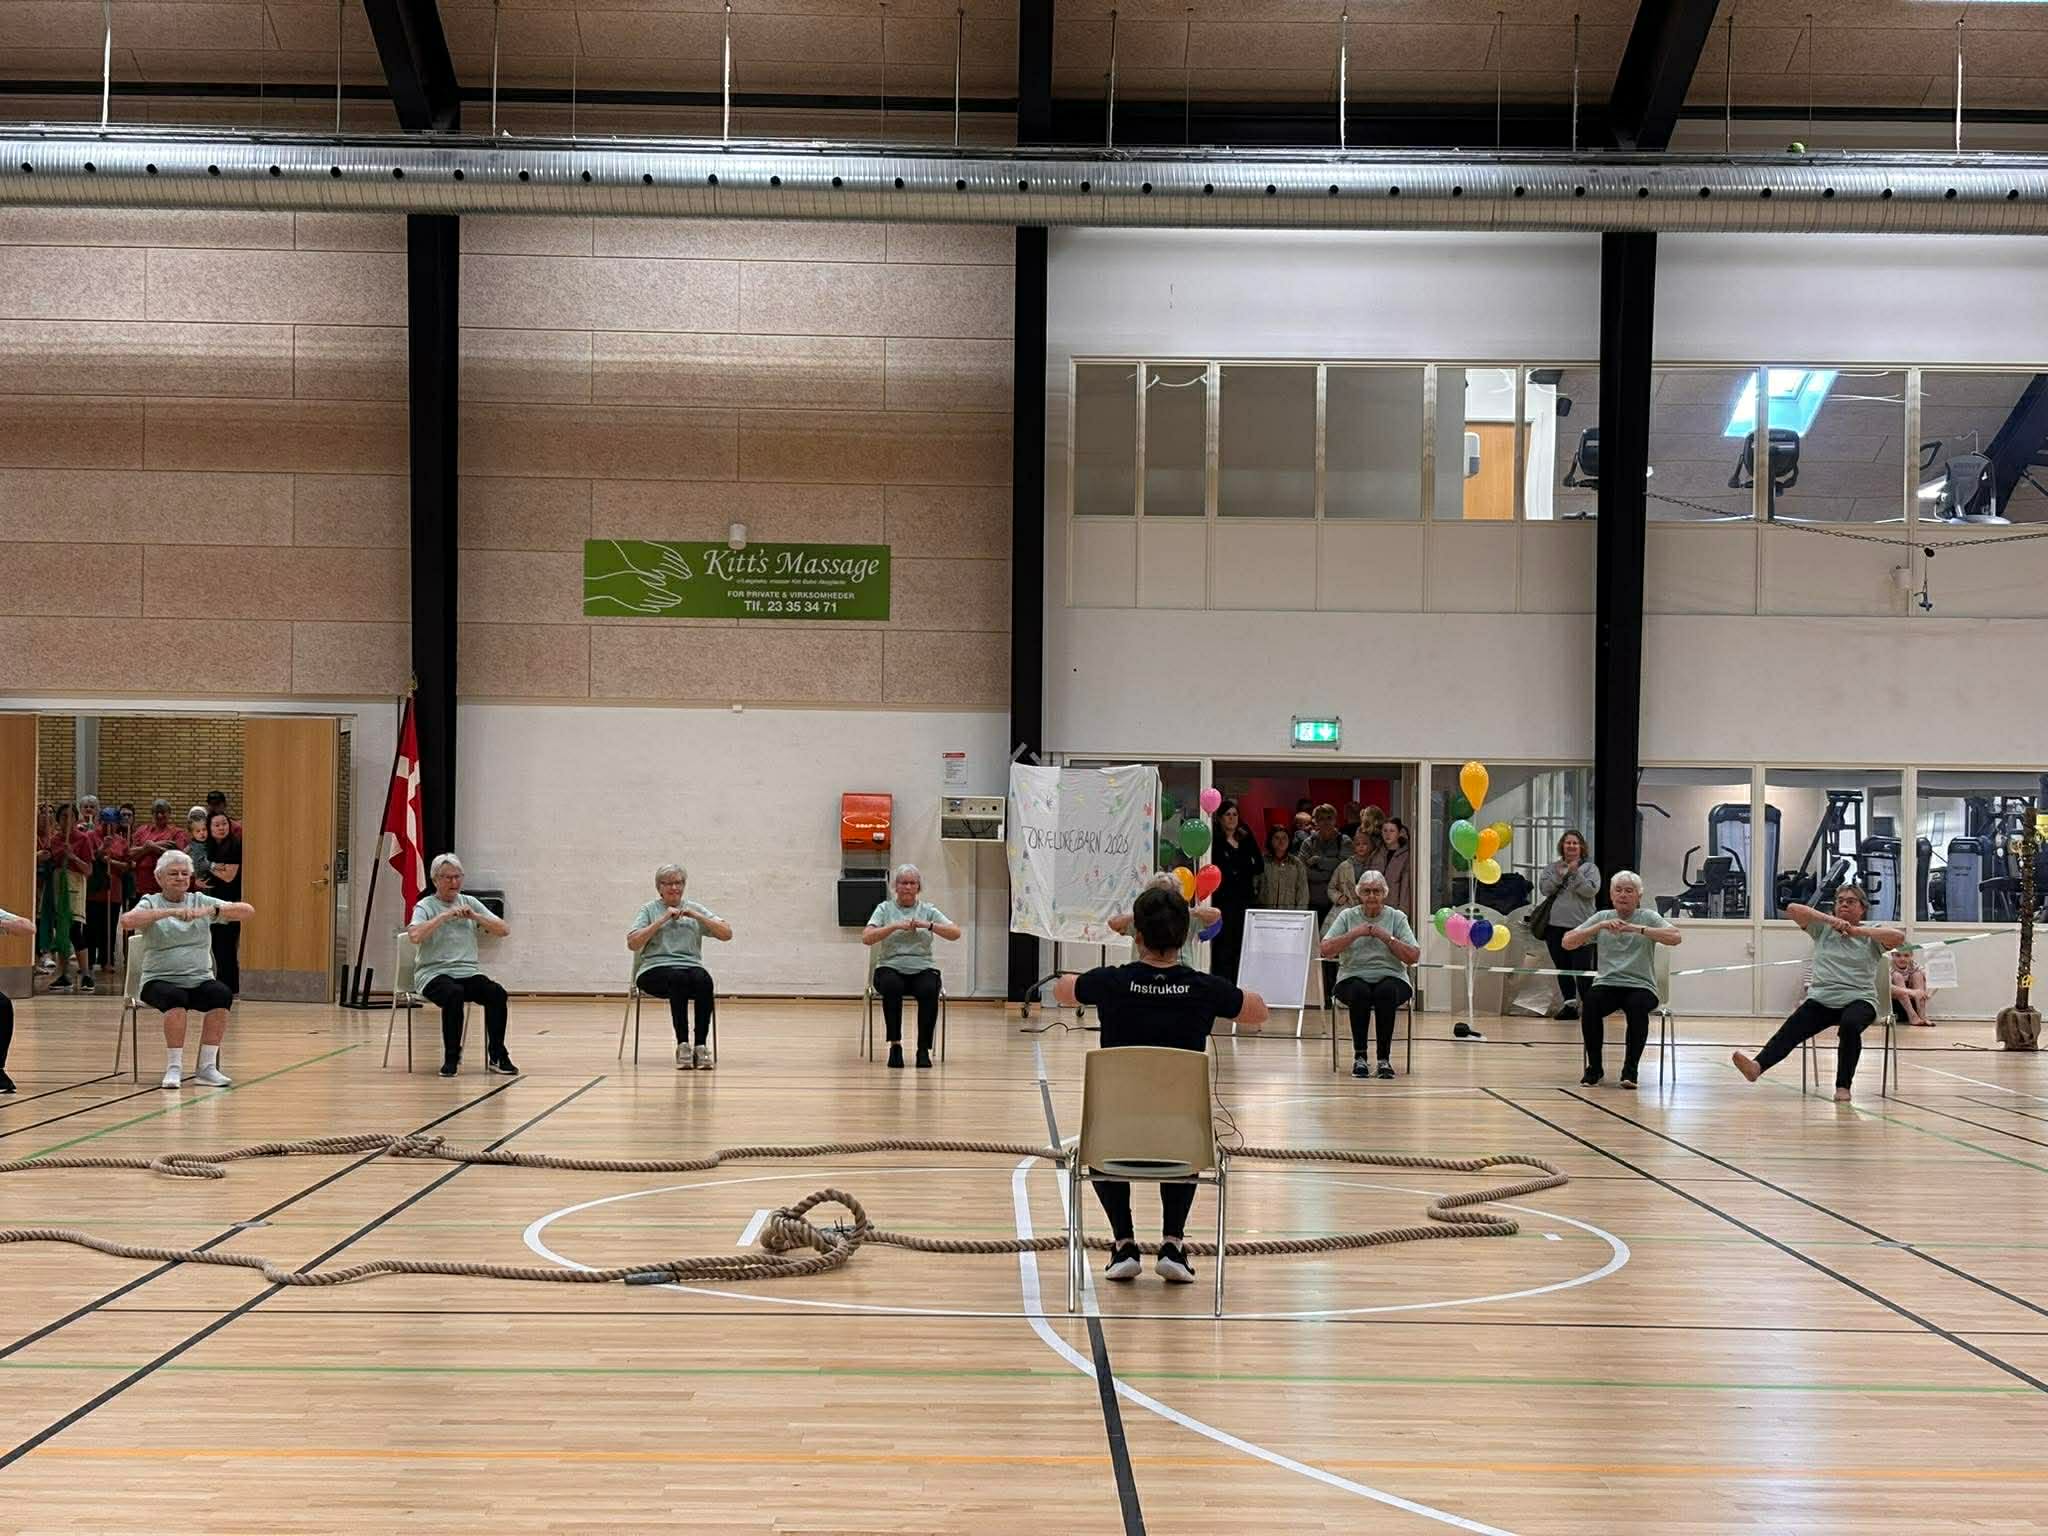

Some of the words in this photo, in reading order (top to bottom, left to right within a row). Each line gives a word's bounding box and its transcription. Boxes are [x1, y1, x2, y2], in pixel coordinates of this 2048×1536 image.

[703, 549, 769, 580] Kitt's
[775, 551, 880, 583] Massage
[727, 590, 745, 598] FOR
[746, 591, 780, 599] PRIVATE
[790, 592, 855, 600] VIRKSOMHEDER
[744, 600, 764, 612] Tlf.
[767, 601, 783, 612] 23
[786, 601, 801, 612] 35
[804, 601, 820, 613] 34
[823, 601, 837, 613] 71
